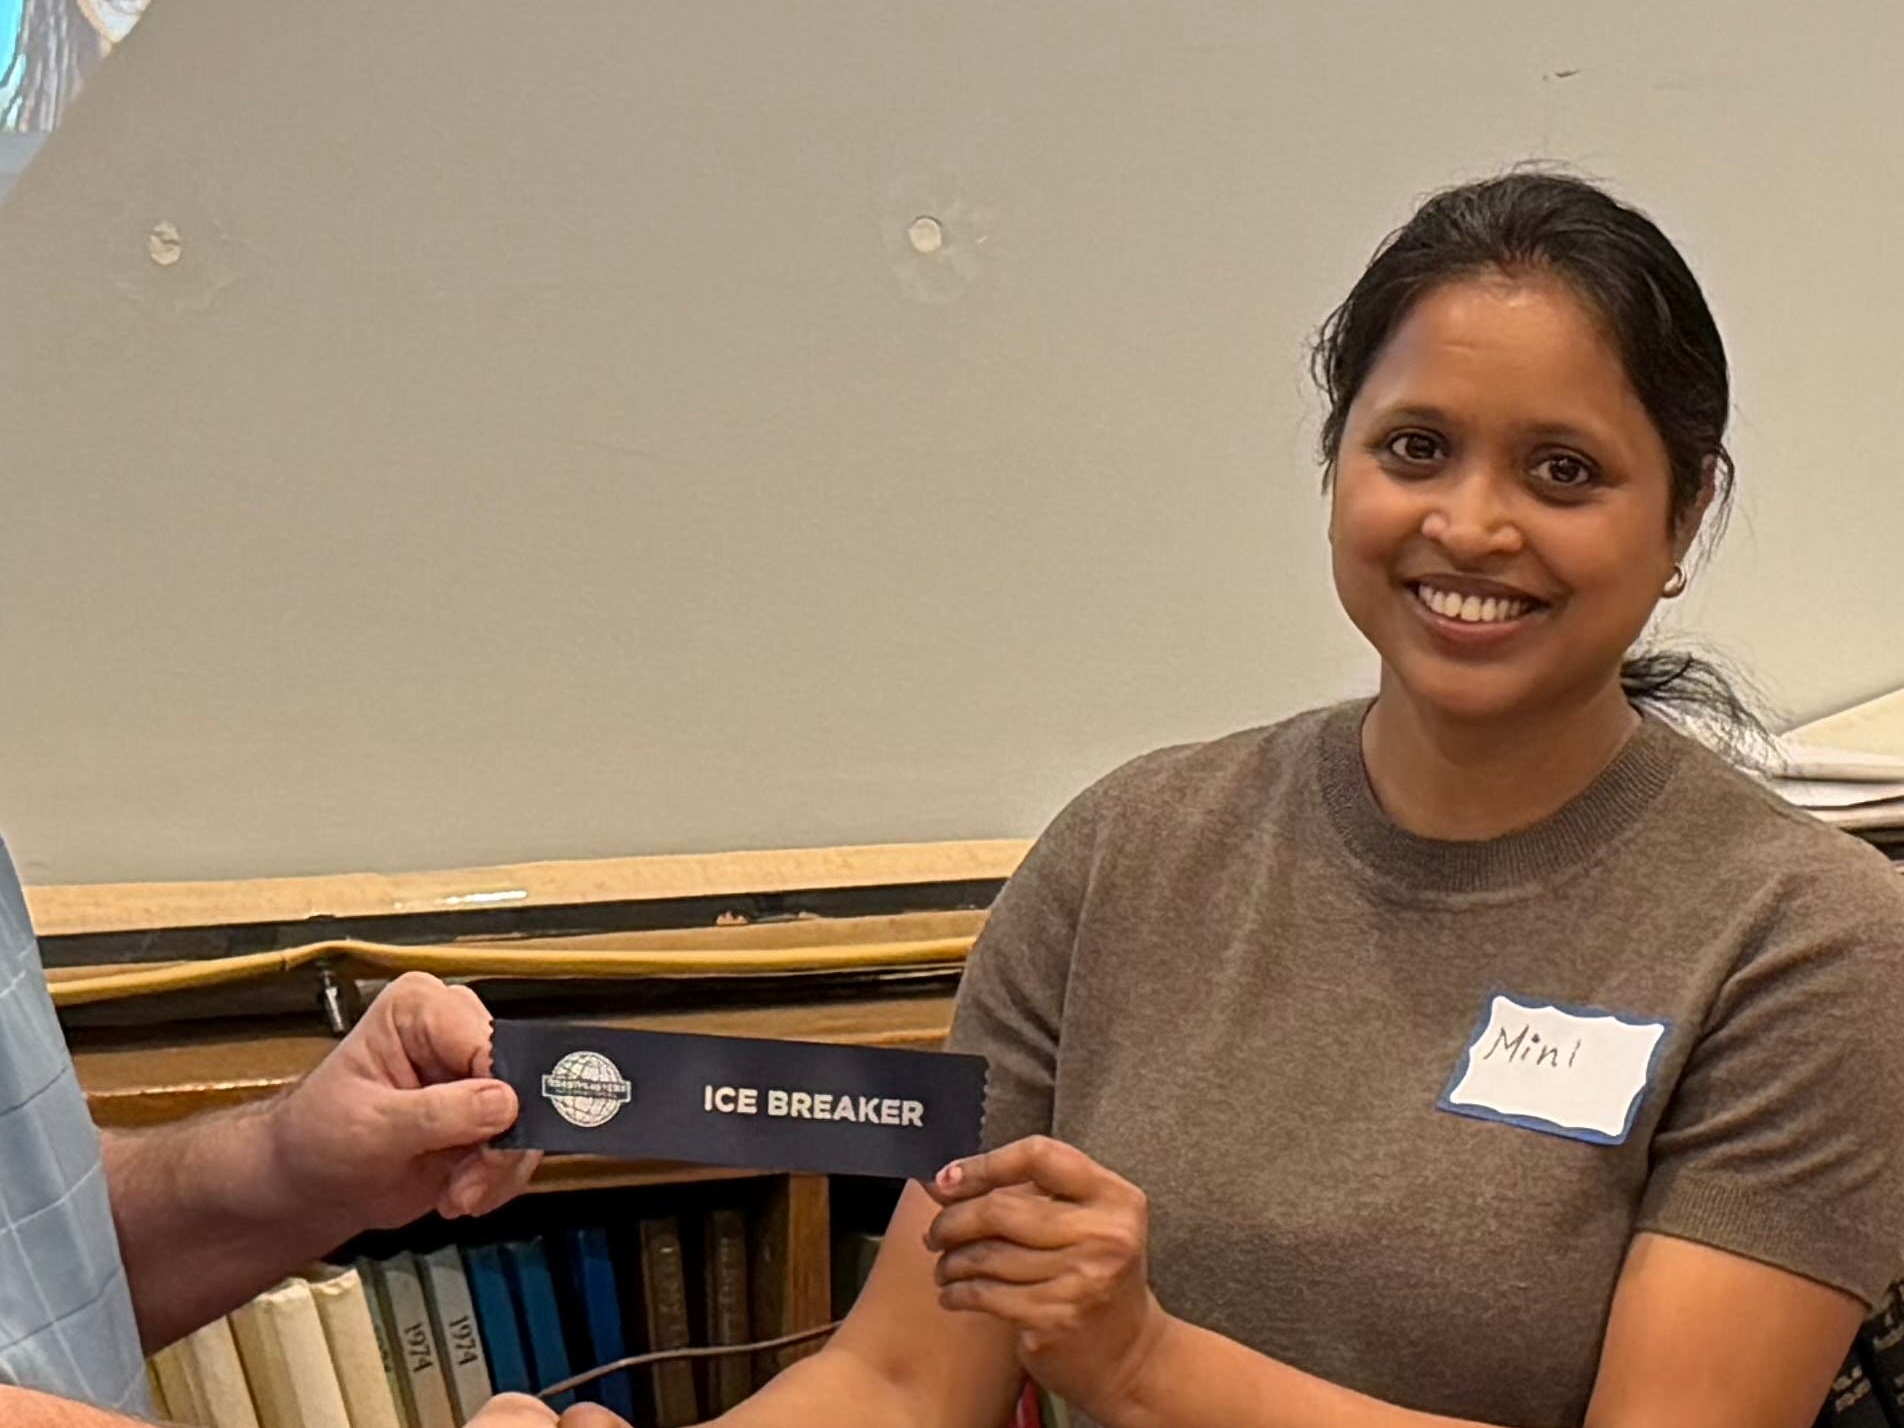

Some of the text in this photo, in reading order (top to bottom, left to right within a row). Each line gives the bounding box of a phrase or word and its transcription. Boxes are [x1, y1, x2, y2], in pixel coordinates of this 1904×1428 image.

[704, 1084, 924, 1128] ICE BREAKER
[404, 1322, 433, 1372] 1974
[449, 1315, 478, 1365] 1974
